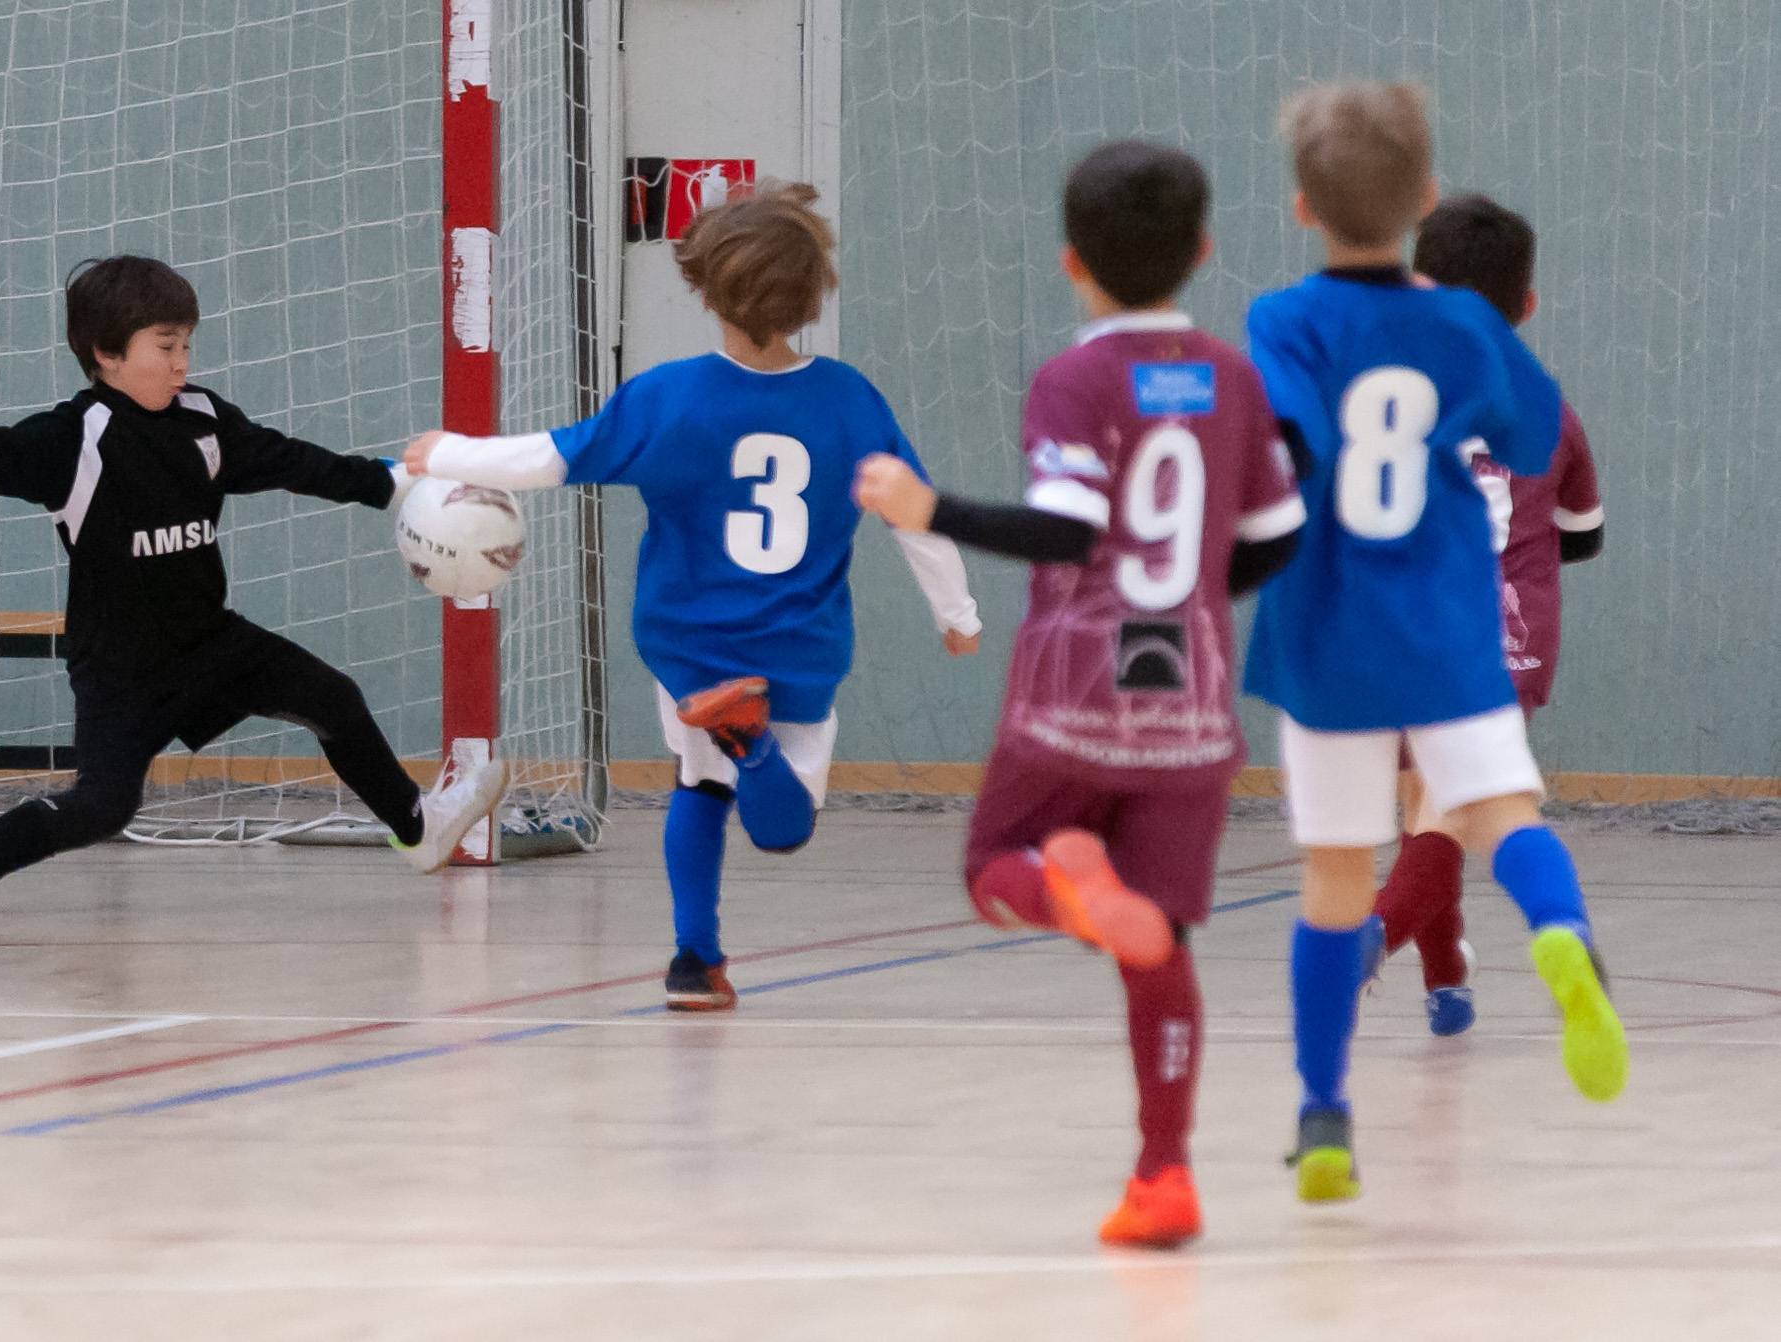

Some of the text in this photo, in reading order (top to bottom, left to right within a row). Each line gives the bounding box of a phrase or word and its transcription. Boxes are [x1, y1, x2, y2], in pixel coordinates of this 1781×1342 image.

[722, 431, 813, 576] 3
[1113, 422, 1207, 612] 9
[1336, 364, 1437, 541] 8
